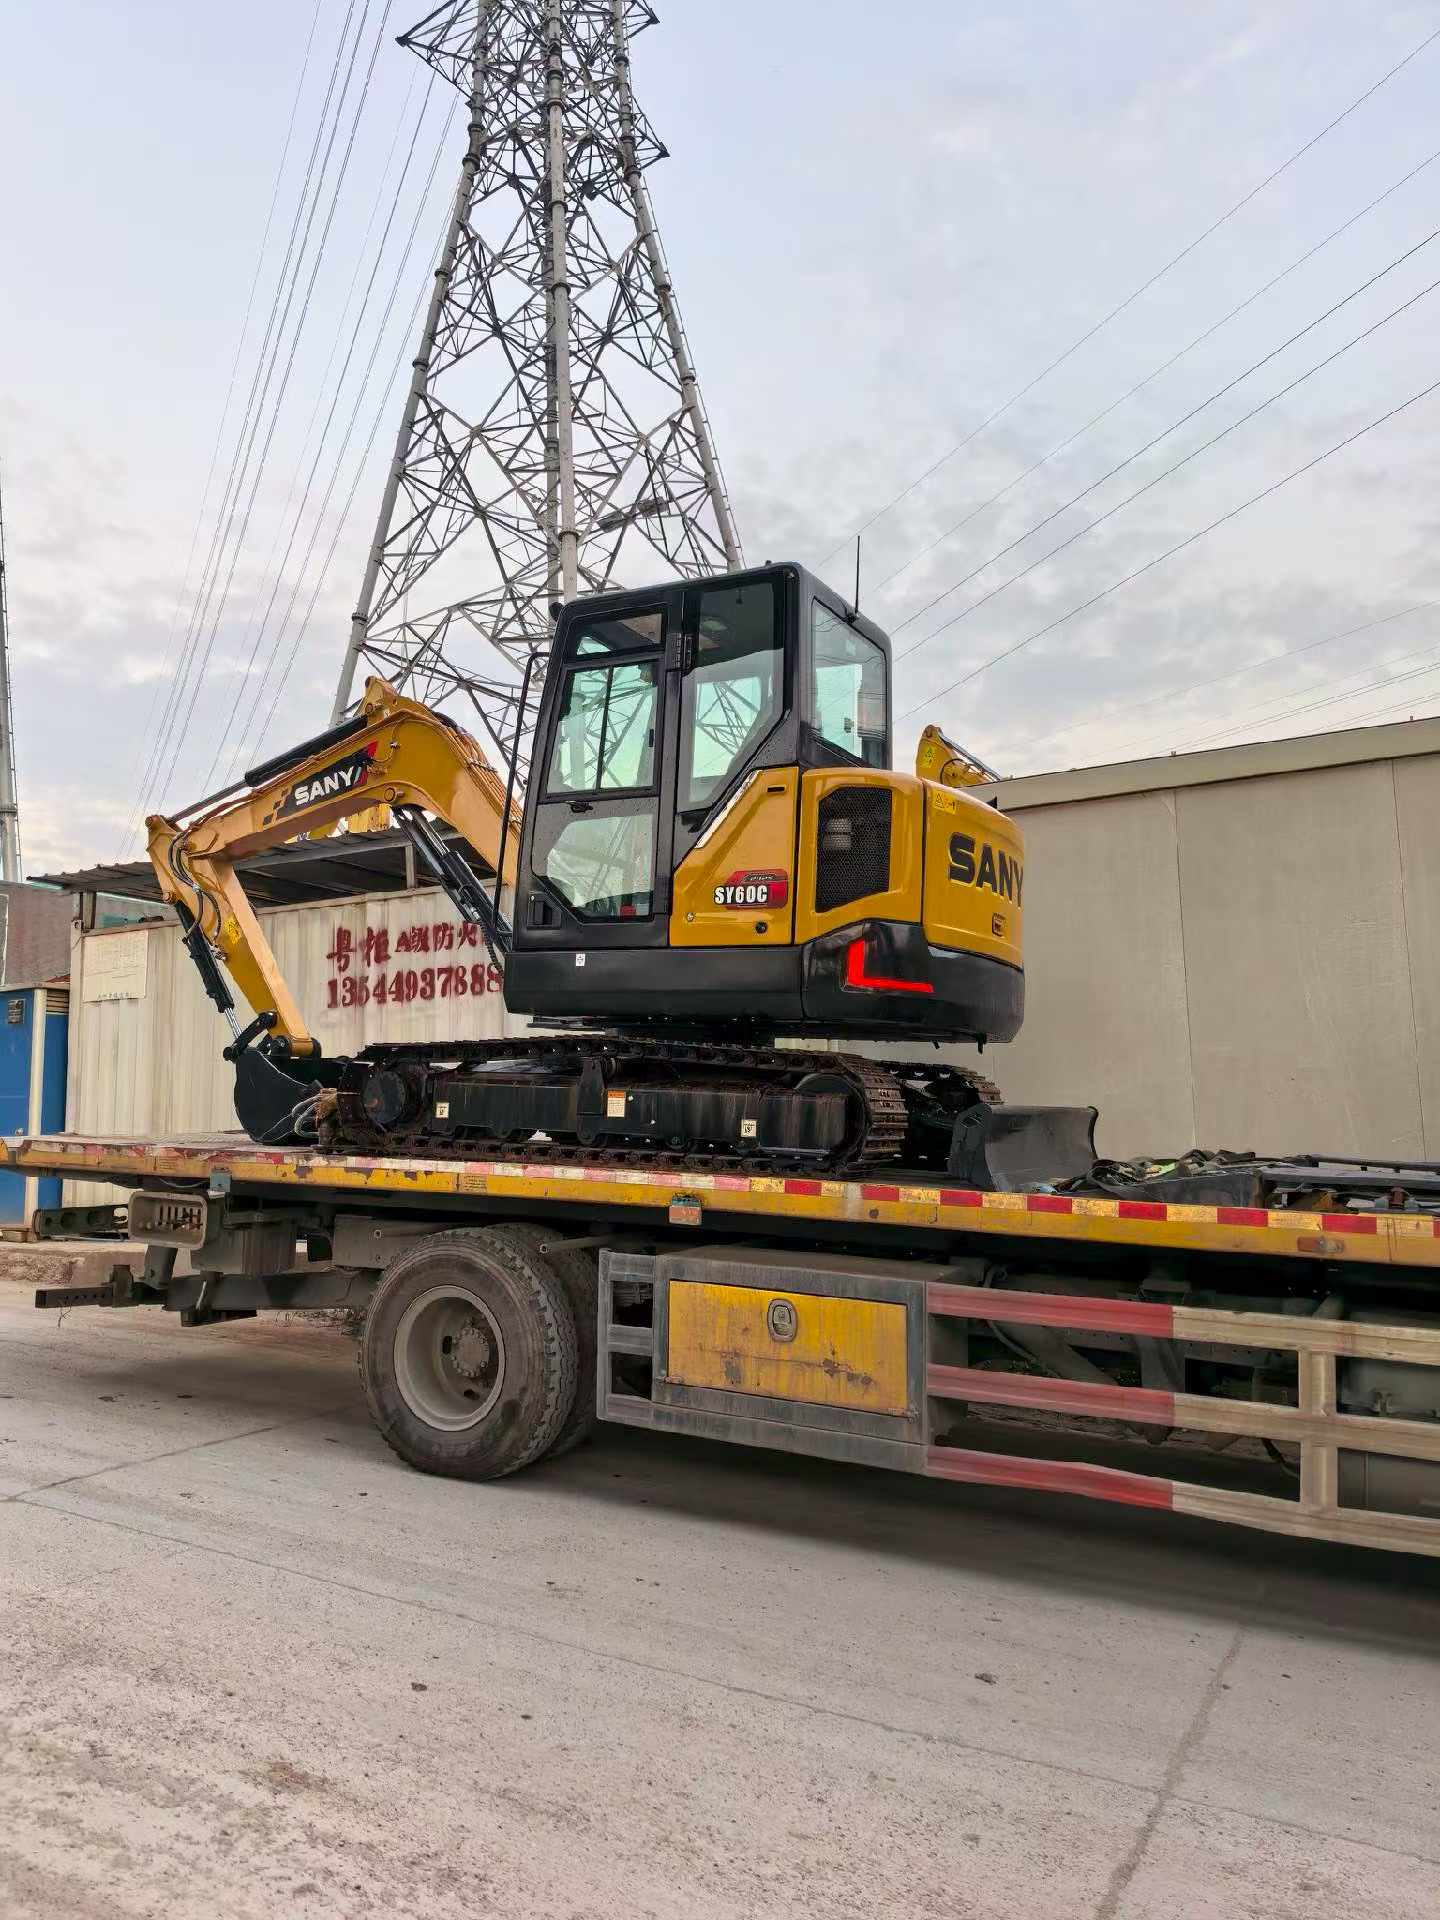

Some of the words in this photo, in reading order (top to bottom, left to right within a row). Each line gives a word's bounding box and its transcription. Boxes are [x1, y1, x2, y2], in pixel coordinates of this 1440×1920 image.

[294, 766, 354, 806] SANY
[948, 831, 1024, 908] SANY
[714, 884, 768, 905] SY60C
